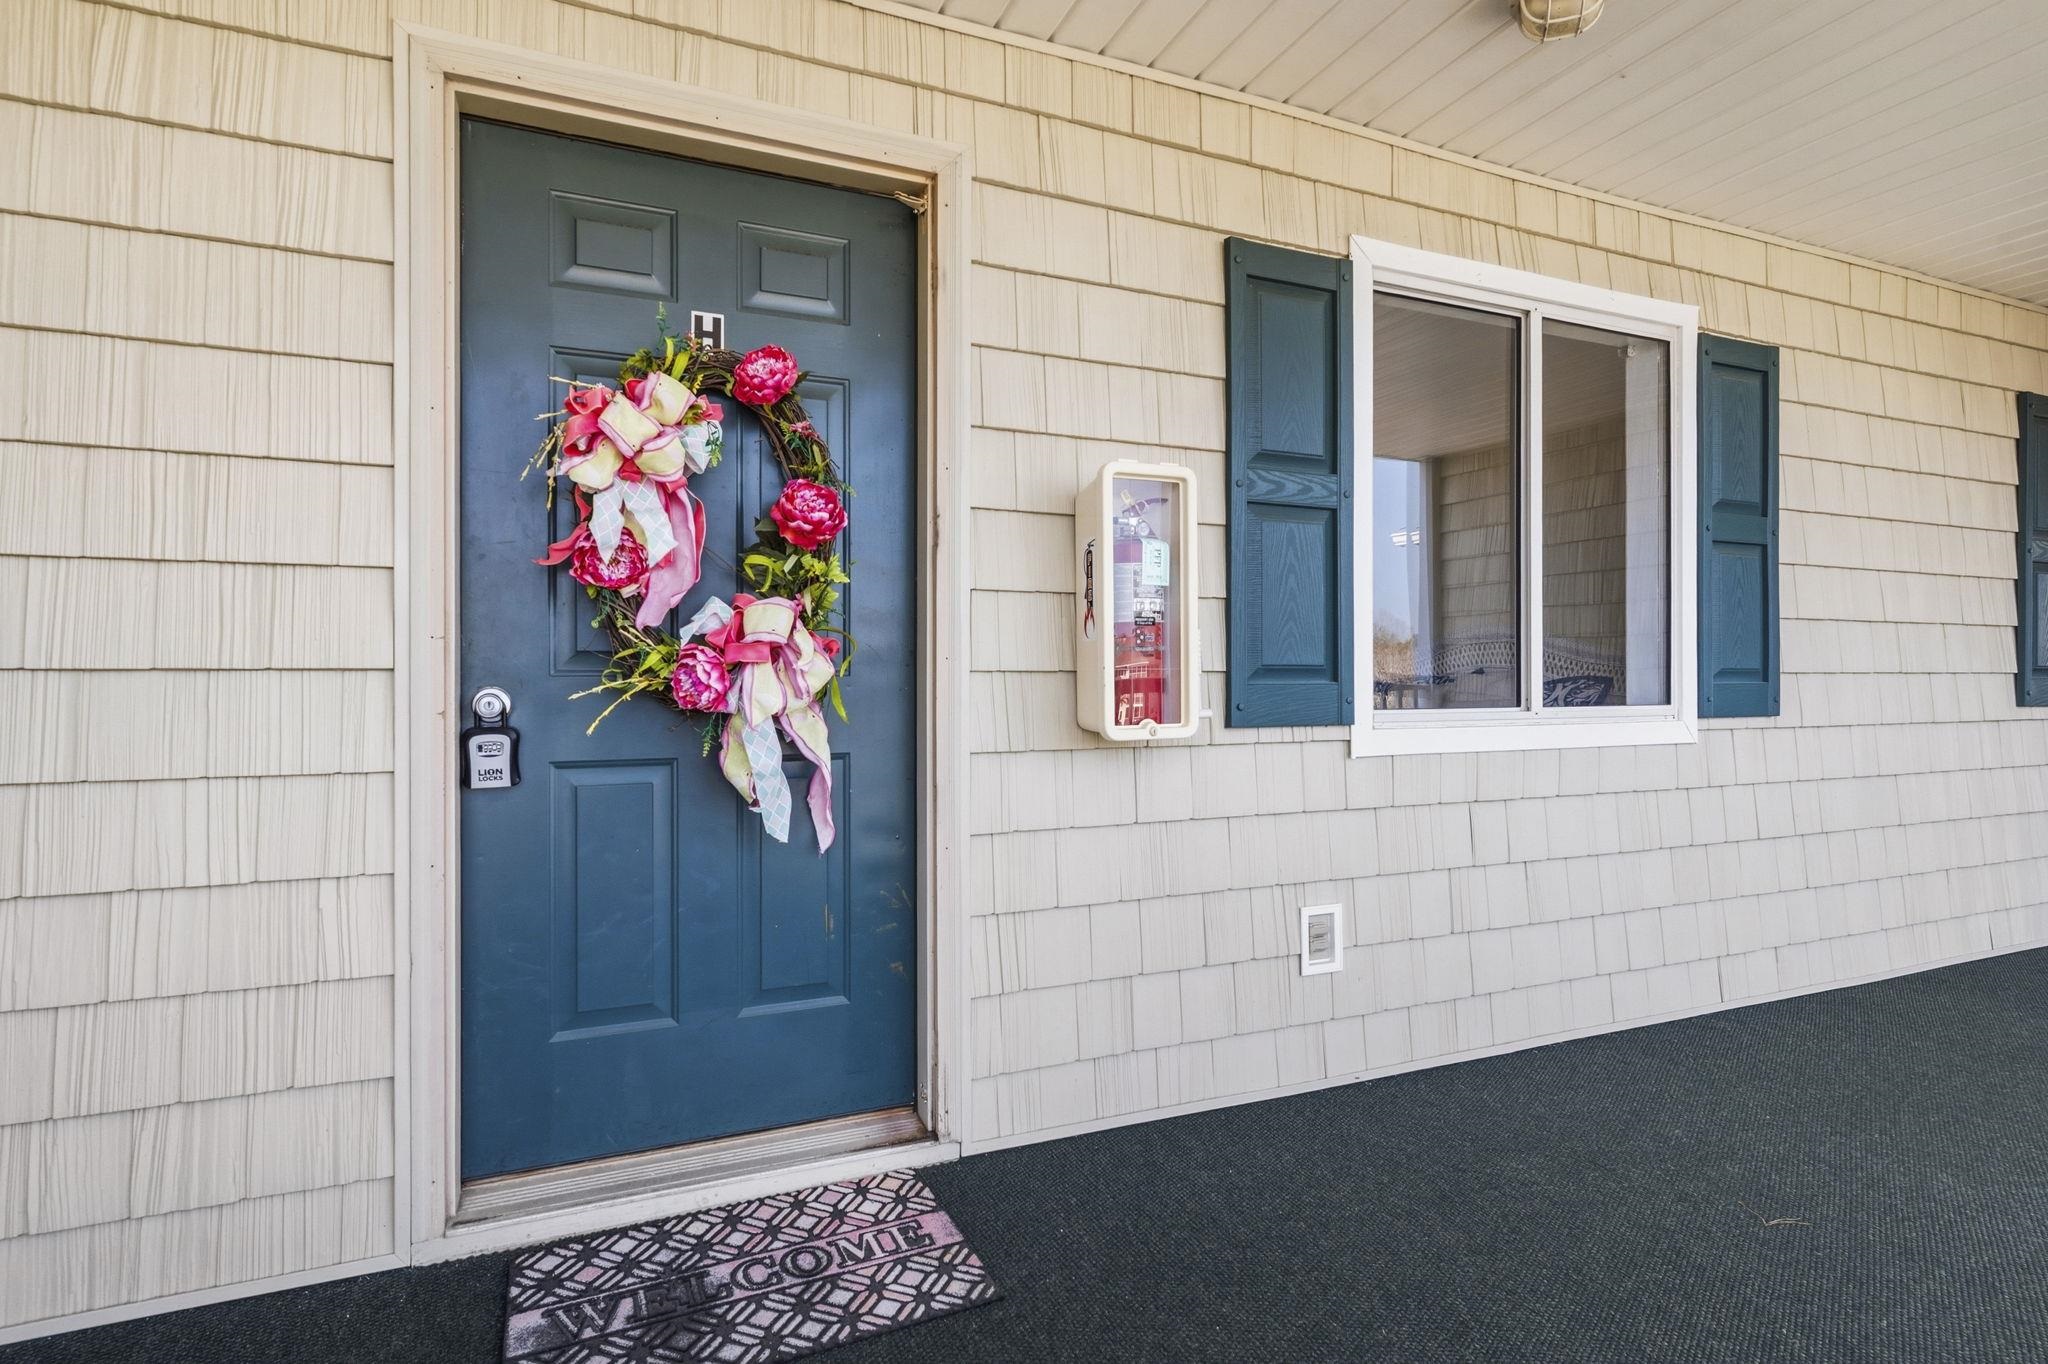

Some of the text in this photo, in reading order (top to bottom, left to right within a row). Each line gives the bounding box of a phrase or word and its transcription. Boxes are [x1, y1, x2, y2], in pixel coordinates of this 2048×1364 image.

[694, 315, 721, 350] H
[477, 768, 503, 776] LION
[550, 1218, 936, 1338] WELCOME
